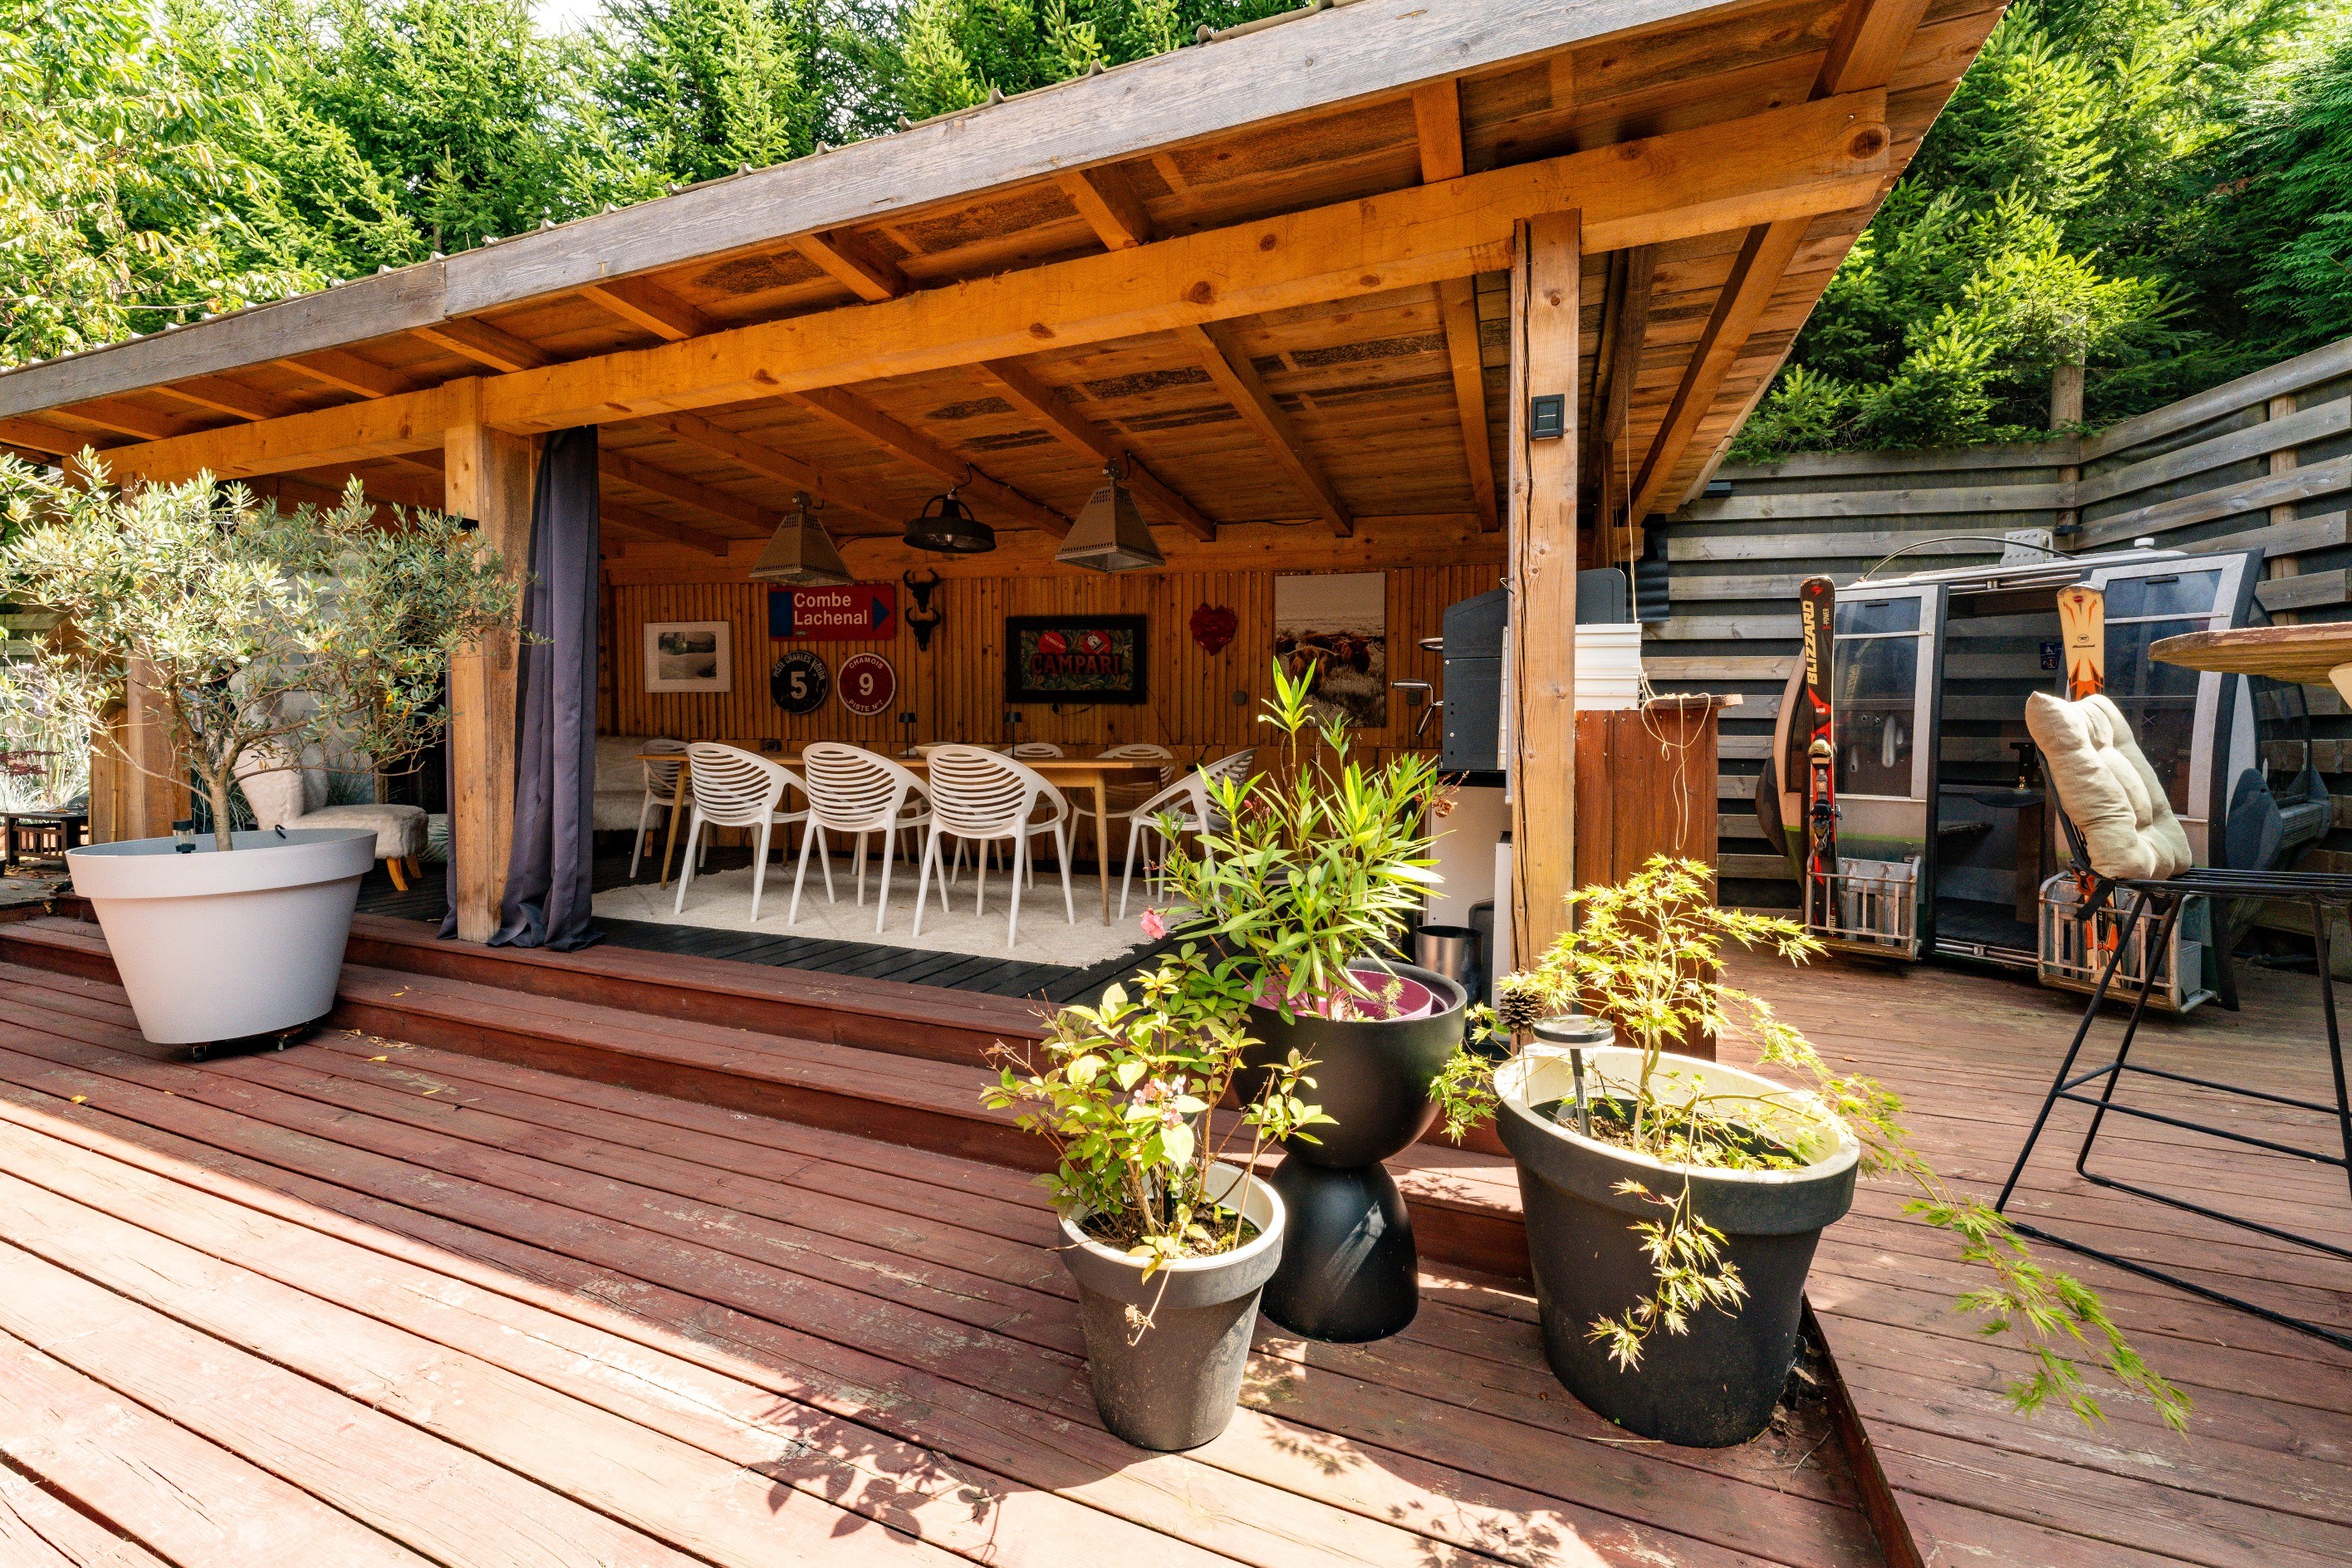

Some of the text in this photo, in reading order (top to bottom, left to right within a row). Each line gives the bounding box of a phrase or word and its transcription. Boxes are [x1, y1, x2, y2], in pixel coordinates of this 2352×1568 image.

[794, 591, 852, 608] Combe
[794, 609, 868, 625] Lachenal
[1802, 600, 1818, 685] BLIZZARD
[772, 660, 786, 678] PISTE
[784, 653, 811, 664] CHARLES
[848, 657, 884, 669] CHAMOIS
[1031, 654, 1120, 674] CAMPARI
[790, 670, 807, 699] 5
[859, 673, 874, 696] 9
[848, 698, 870, 712] PISTE
